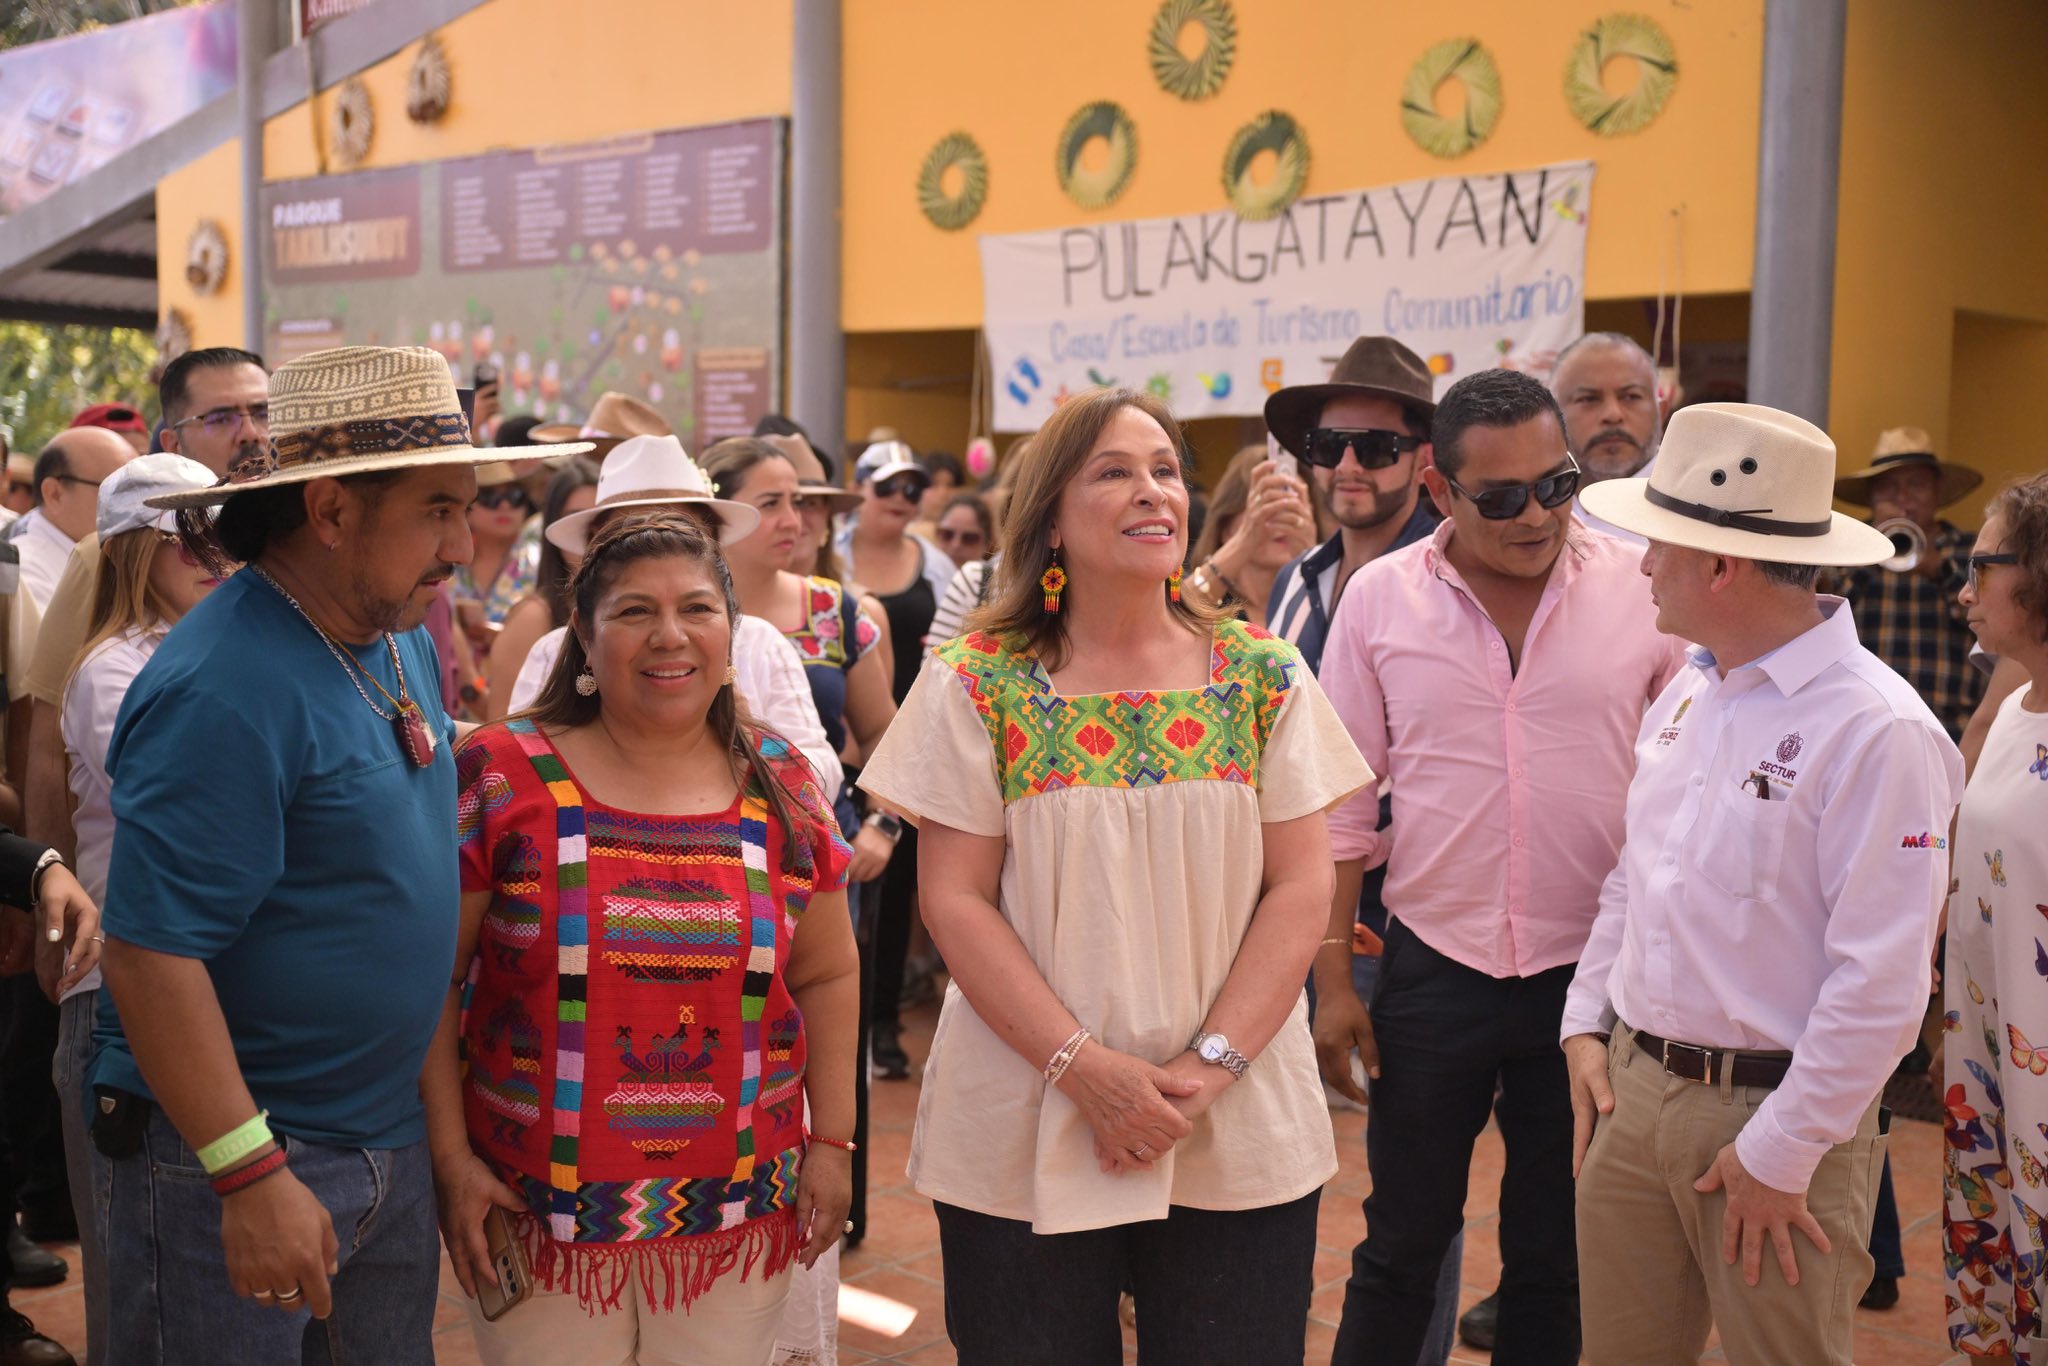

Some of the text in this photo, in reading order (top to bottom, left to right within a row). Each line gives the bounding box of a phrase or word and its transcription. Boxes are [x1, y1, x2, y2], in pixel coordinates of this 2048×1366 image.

[1061, 169, 1548, 307] PULAKGATAYAN
[1253, 298, 1361, 346] Turismo
[1382, 268, 1574, 334] Comunitario
[1758, 760, 1797, 781] SECTUR
